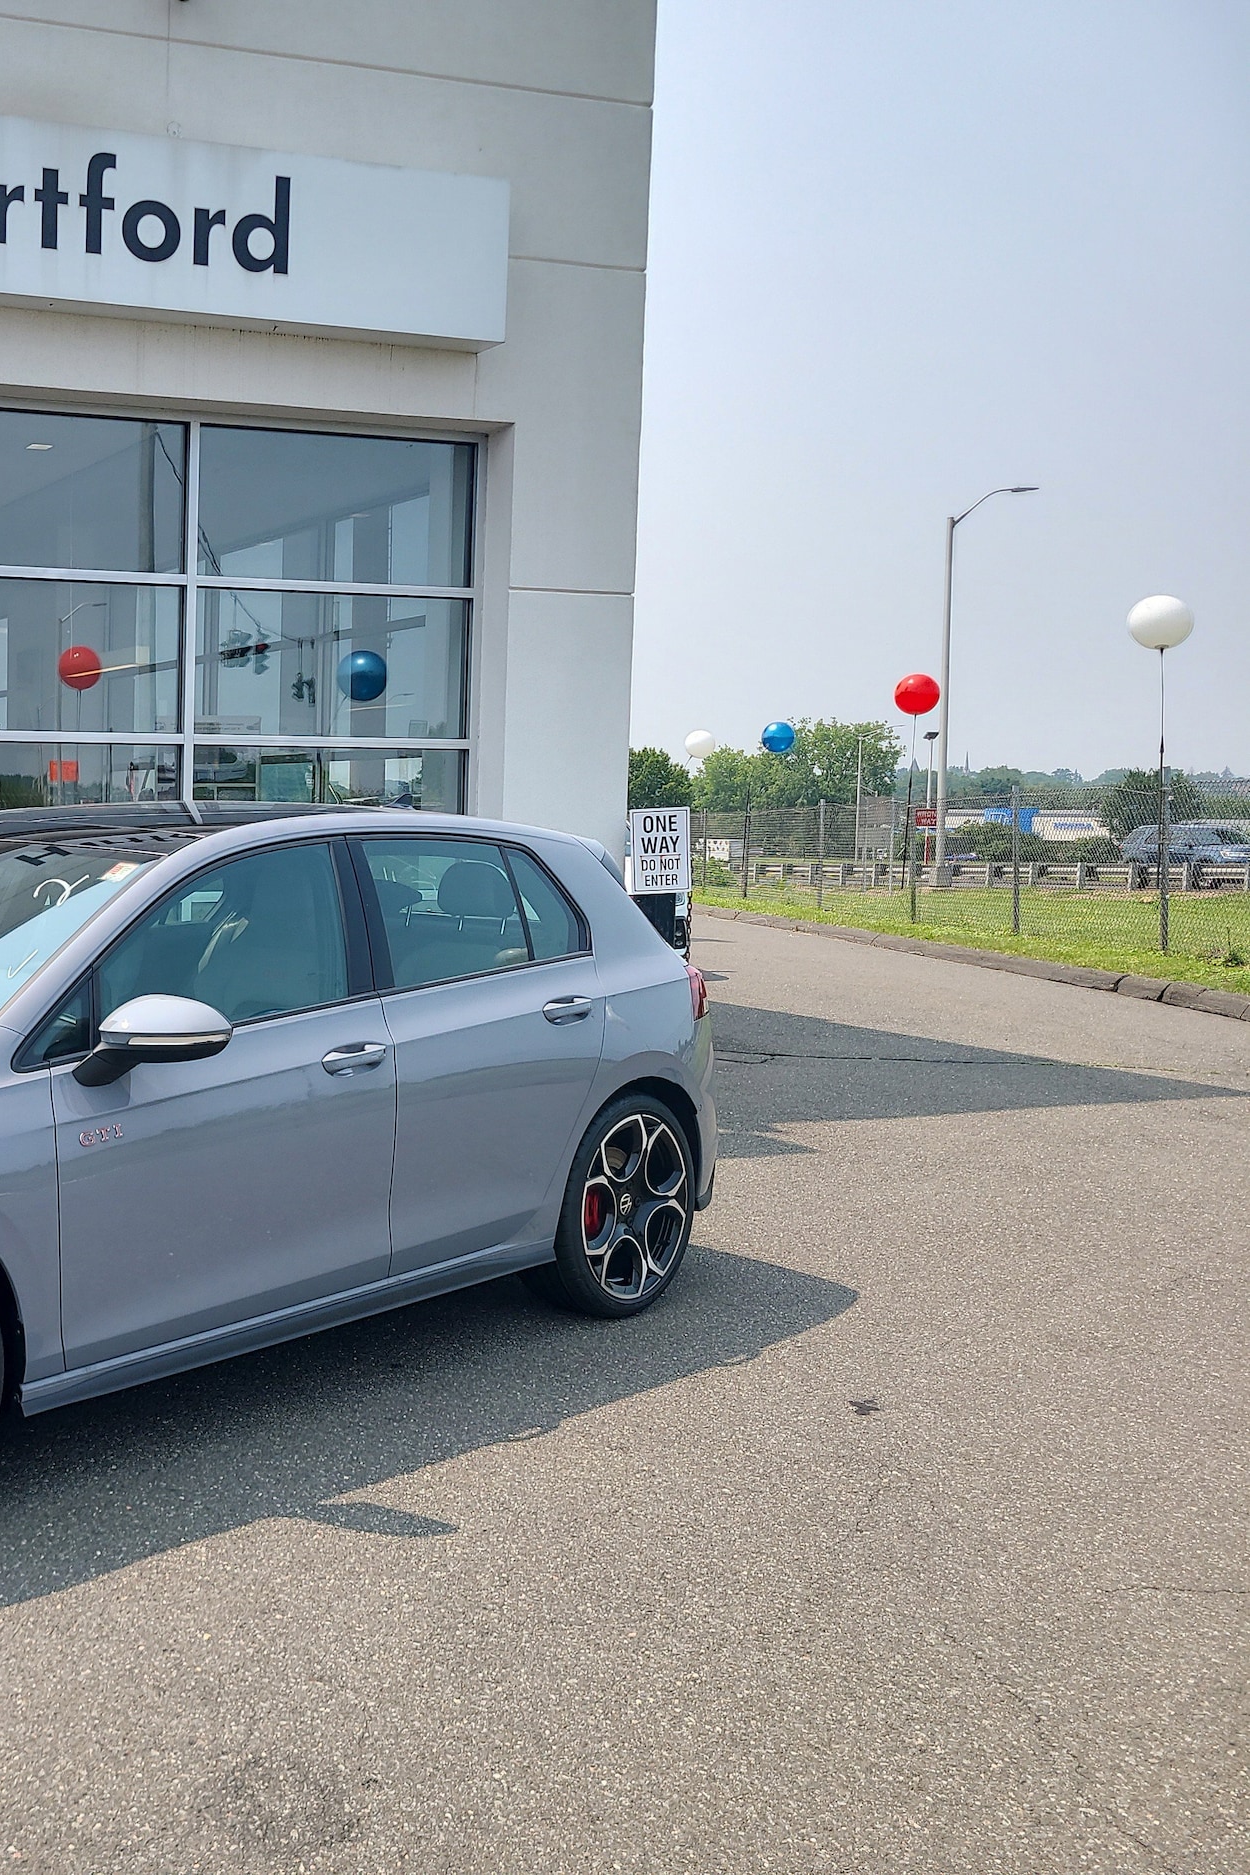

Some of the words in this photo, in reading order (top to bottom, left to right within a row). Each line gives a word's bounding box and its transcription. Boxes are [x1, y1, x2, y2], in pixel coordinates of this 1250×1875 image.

[643, 814, 678, 833] ONE
[640, 835, 680, 854] WAY
[641, 859, 656, 872] DO
[660, 858, 681, 871] NOT
[644, 873, 679, 887] ENTER
[79, 1123, 124, 1147] GTI
